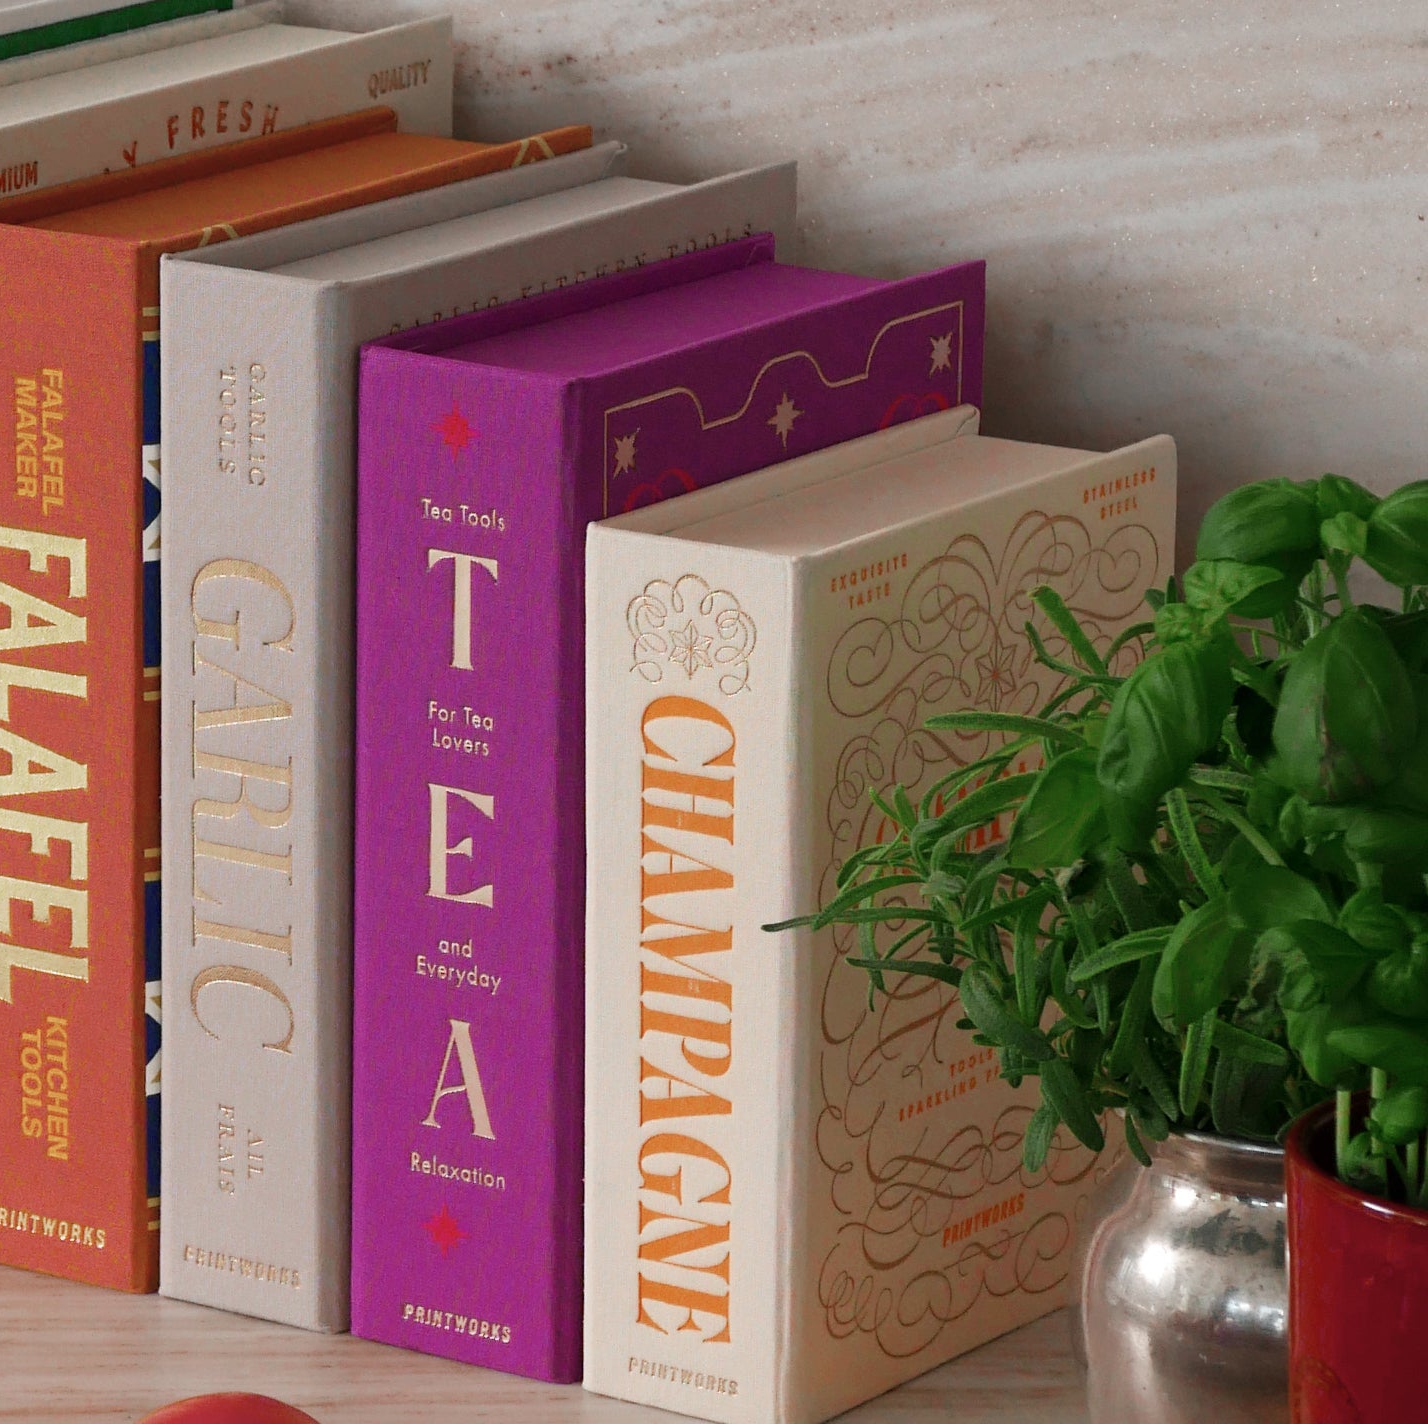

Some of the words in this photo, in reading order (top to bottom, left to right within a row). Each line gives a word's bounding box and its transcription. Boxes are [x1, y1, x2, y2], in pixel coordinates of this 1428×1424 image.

[368, 59, 432, 100] QUALITY
[166, 100, 279, 150] FRESH
[13, 375, 39, 499] MAKER
[41, 367, 66, 517] FALAFEL
[218, 365, 238, 475] TOOLS
[247, 361, 267, 488] GARLIC
[1082, 466, 1157, 505] STAINLESS
[1099, 495, 1139, 520] STEEL
[420, 497, 452, 523] Tea
[458, 503, 506, 532] Tools
[830, 552, 909, 594] EXQUISITE
[847, 581, 891, 611] TASTE
[427, 700, 457, 723] For
[462, 706, 494, 731] Tea
[432, 727, 490, 757] Lovers
[189, 556, 298, 1057] GARLIC
[421, 547, 499, 1140] TEA
[438, 937, 473, 959] and
[415, 953, 502, 997] Everyday
[635, 694, 738, 1345] CHAMPAGNE
[20, 1028, 43, 1139] TOOLS
[46, 1015, 70, 1162] KITCHEN
[218, 1102, 236, 1196] FRAIS
[247, 1127, 265, 1179] AIL
[410, 1151, 507, 1191] Relaxation
[941, 1192, 1026, 1249] PRINTWORKS
[182, 1243, 303, 1290] PRINTWORKS
[402, 1301, 513, 1344] PRINTWORKS
[628, 1356, 740, 1397] PRINTWORKS
